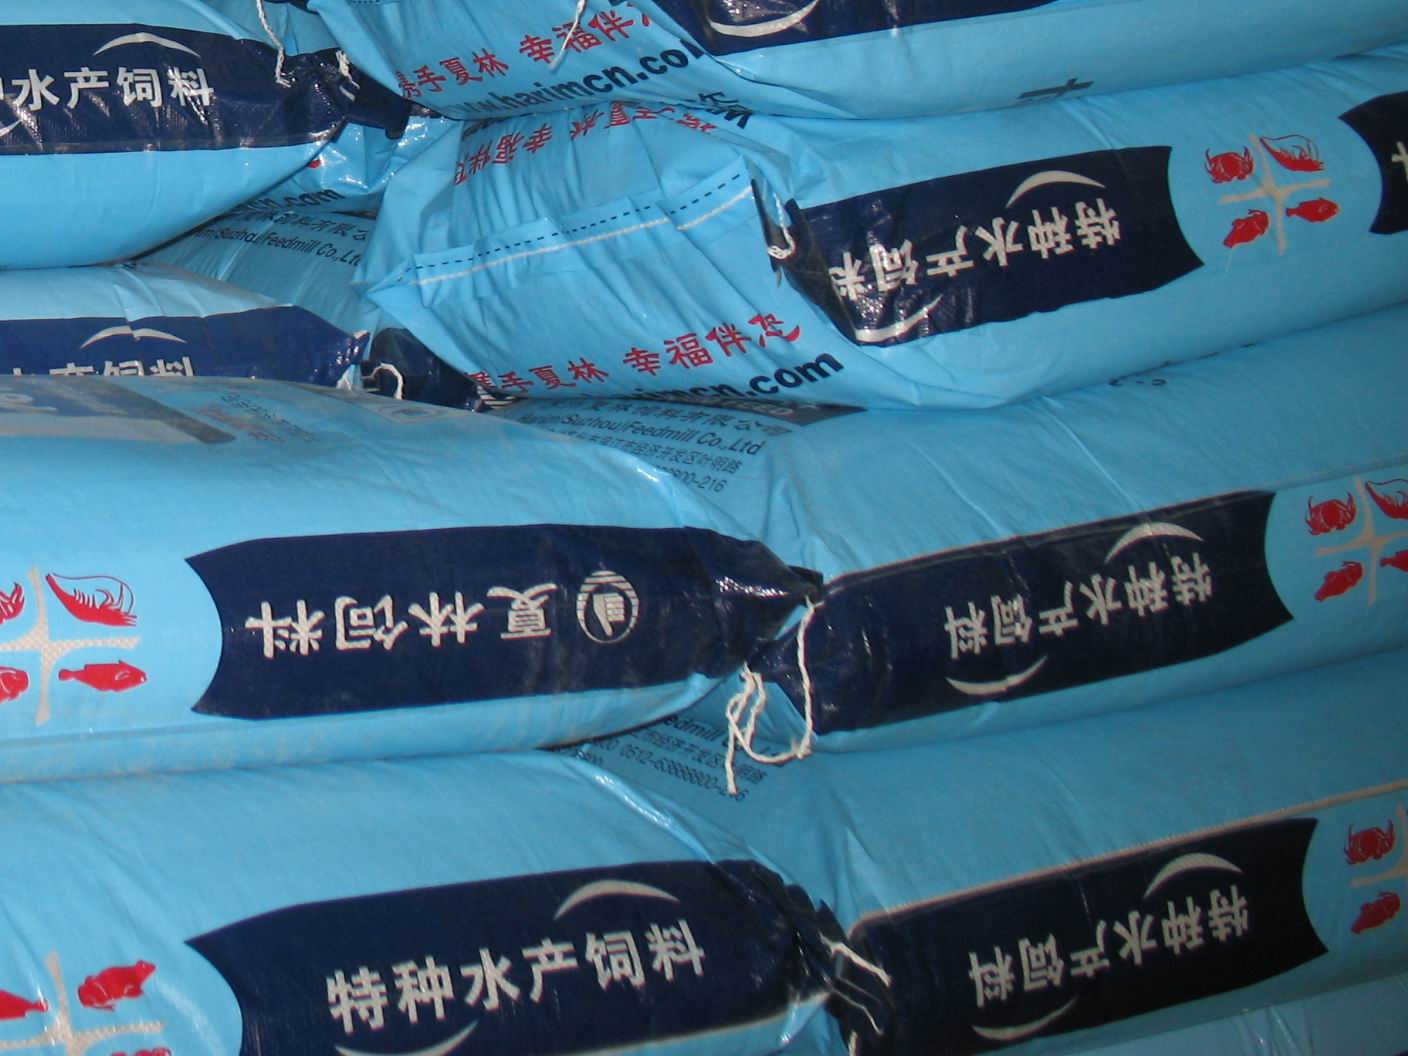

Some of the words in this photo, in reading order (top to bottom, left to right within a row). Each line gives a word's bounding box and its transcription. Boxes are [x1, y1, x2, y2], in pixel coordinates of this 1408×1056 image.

[829, 198, 1121, 300] 特种水产饲料
[246, 583, 558, 658] 夏林饲料
[944, 552, 1213, 659] 特种水产饲料
[327, 920, 706, 1034] 特种水产饲料
[969, 885, 1251, 1008] 特种水产饲料
